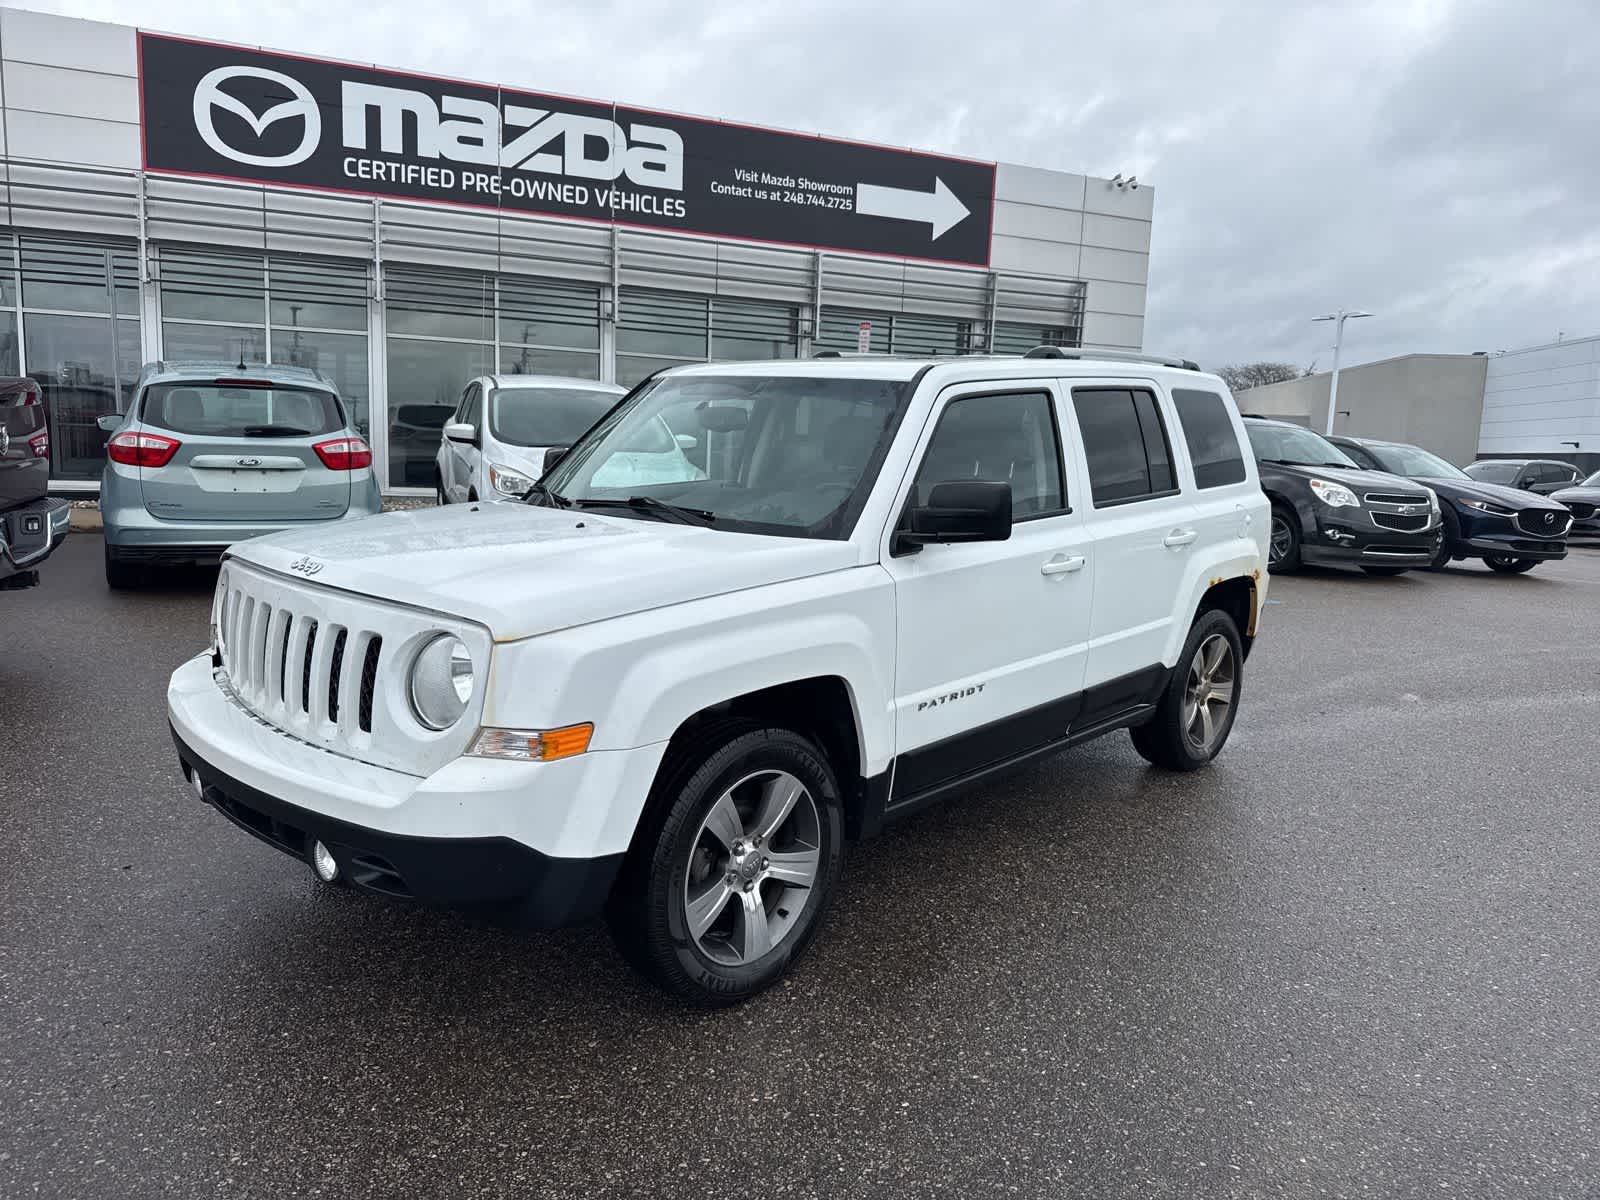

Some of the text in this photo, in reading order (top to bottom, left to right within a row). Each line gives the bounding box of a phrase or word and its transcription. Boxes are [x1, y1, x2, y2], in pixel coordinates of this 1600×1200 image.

[343, 157, 687, 218] CERTIFIED PRE-OWNED VEHICLES
[710, 181, 853, 210] Contact us at 248.744.2725
[735, 168, 854, 196] Visit Mazda Showroom
[917, 683, 986, 712] PATRIOT
